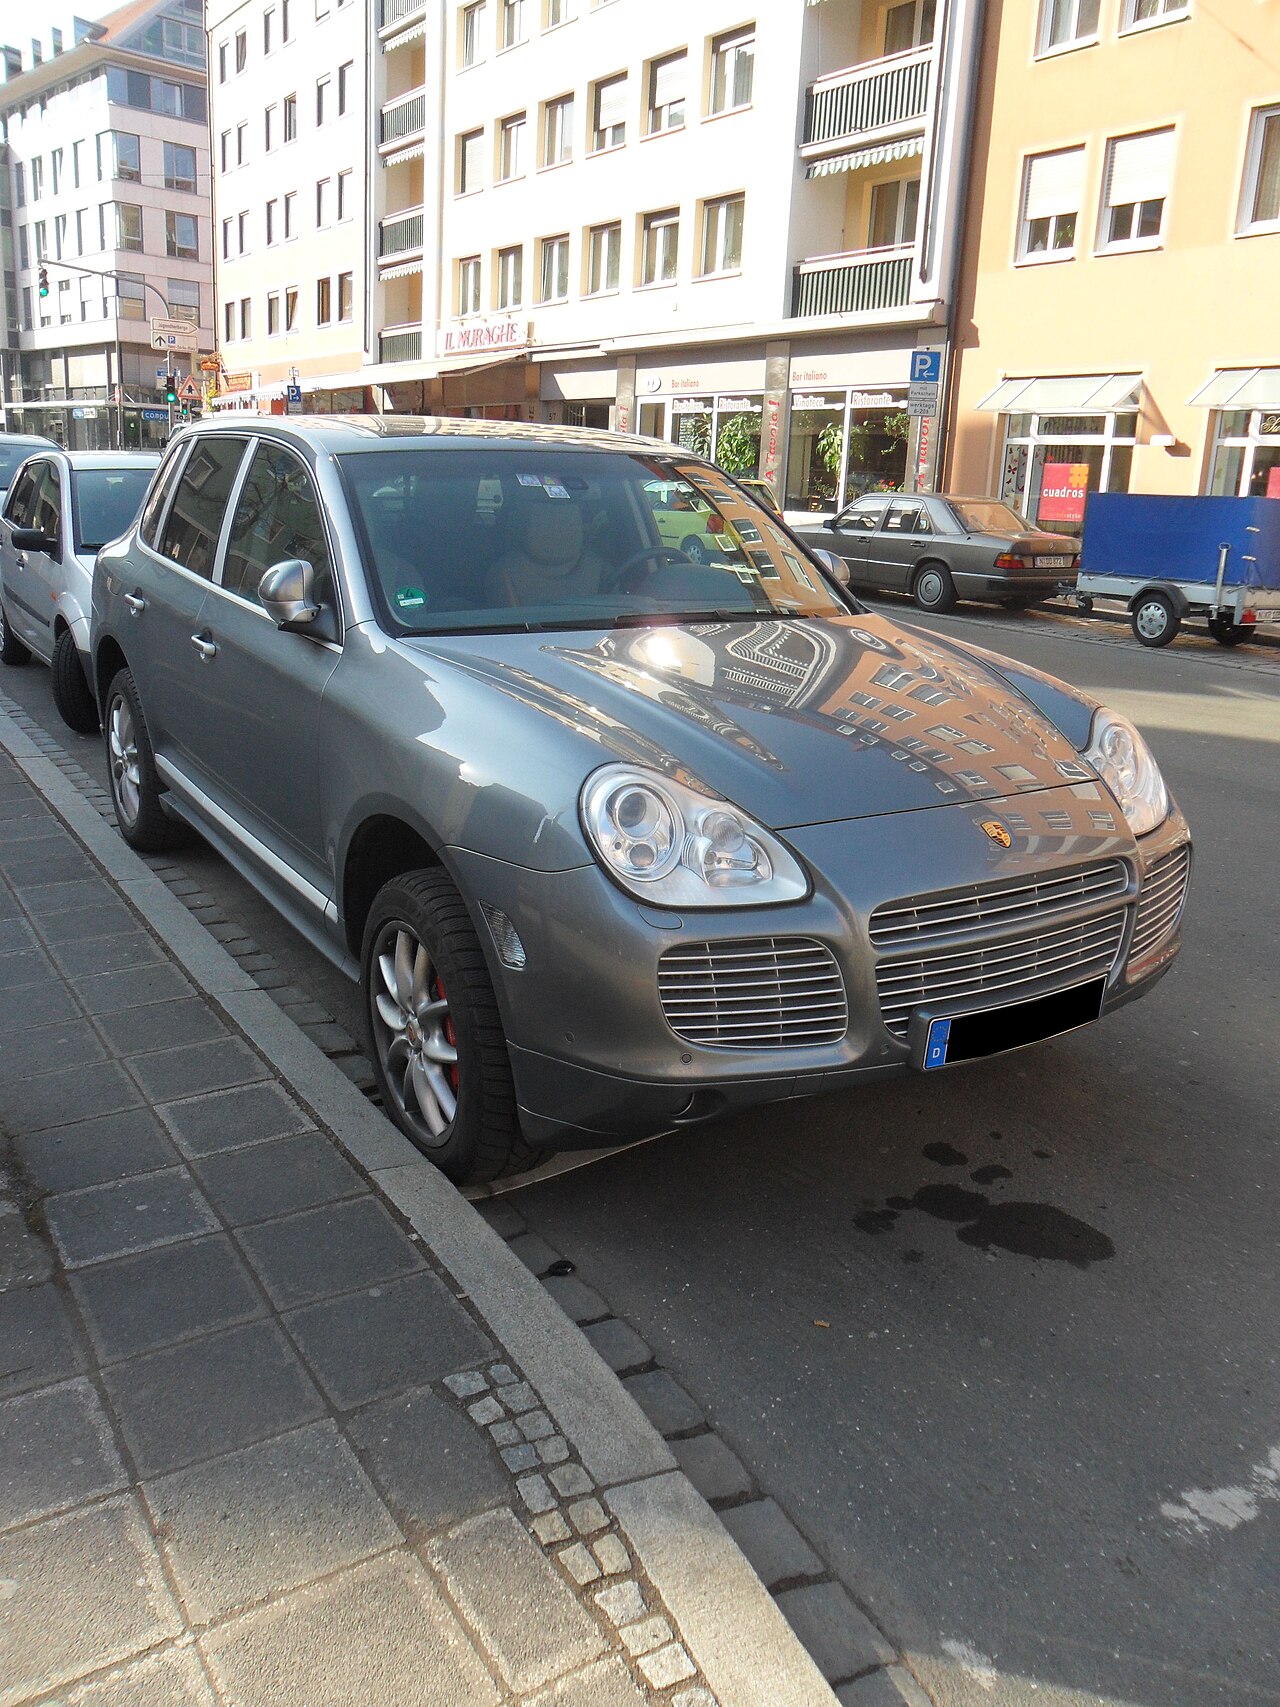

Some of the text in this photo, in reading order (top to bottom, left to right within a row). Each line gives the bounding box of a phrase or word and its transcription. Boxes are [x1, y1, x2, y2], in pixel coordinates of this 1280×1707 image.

[915, 354, 932, 378] P
[792, 370, 828, 381] Bar italiano
[671, 378, 700, 388] Bar italiano
[289, 387, 297, 401] P
[853, 393, 892, 407] Ristorante
[719, 398, 750, 411] Ristorante
[794, 396, 824, 408] Vinoteca
[765, 412, 779, 464] Tavola
[765, 470, 775, 483] A
[1043, 486, 1084, 498] cuadros
[932, 1047, 941, 1058] D
